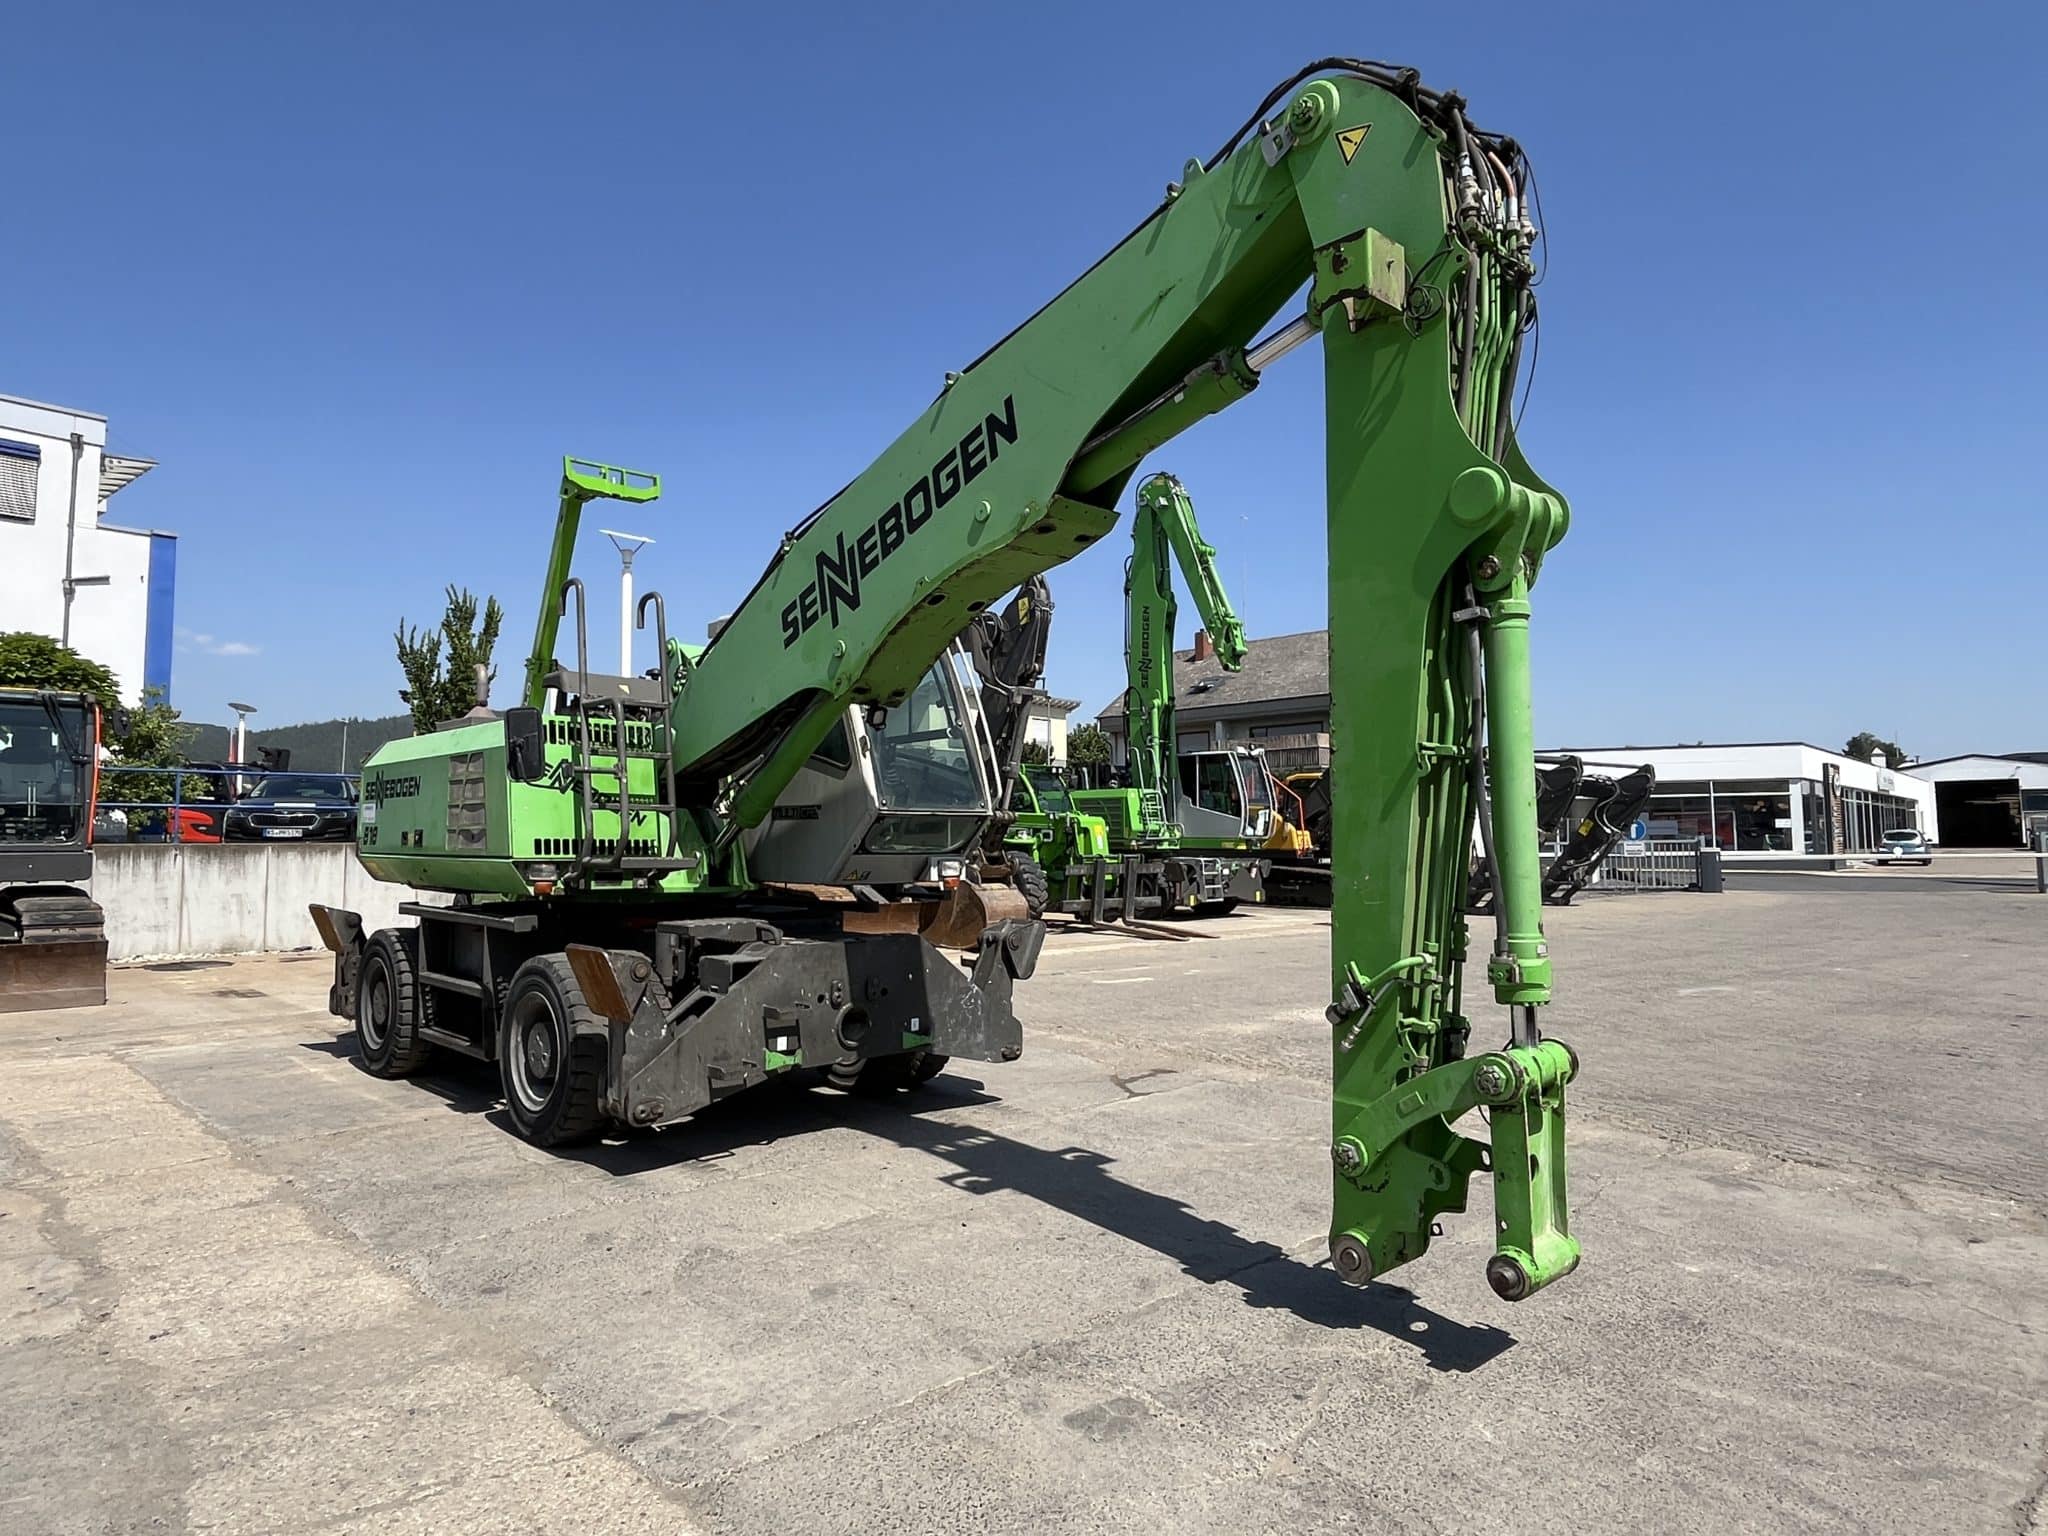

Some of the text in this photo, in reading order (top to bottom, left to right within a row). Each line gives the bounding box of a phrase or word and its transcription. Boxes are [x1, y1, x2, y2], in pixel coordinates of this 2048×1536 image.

[781, 394, 1018, 650] SENNEBOGEN
[1138, 605, 1152, 689] SENNEBOGEN
[365, 770, 421, 810] SENNEBOGEN
